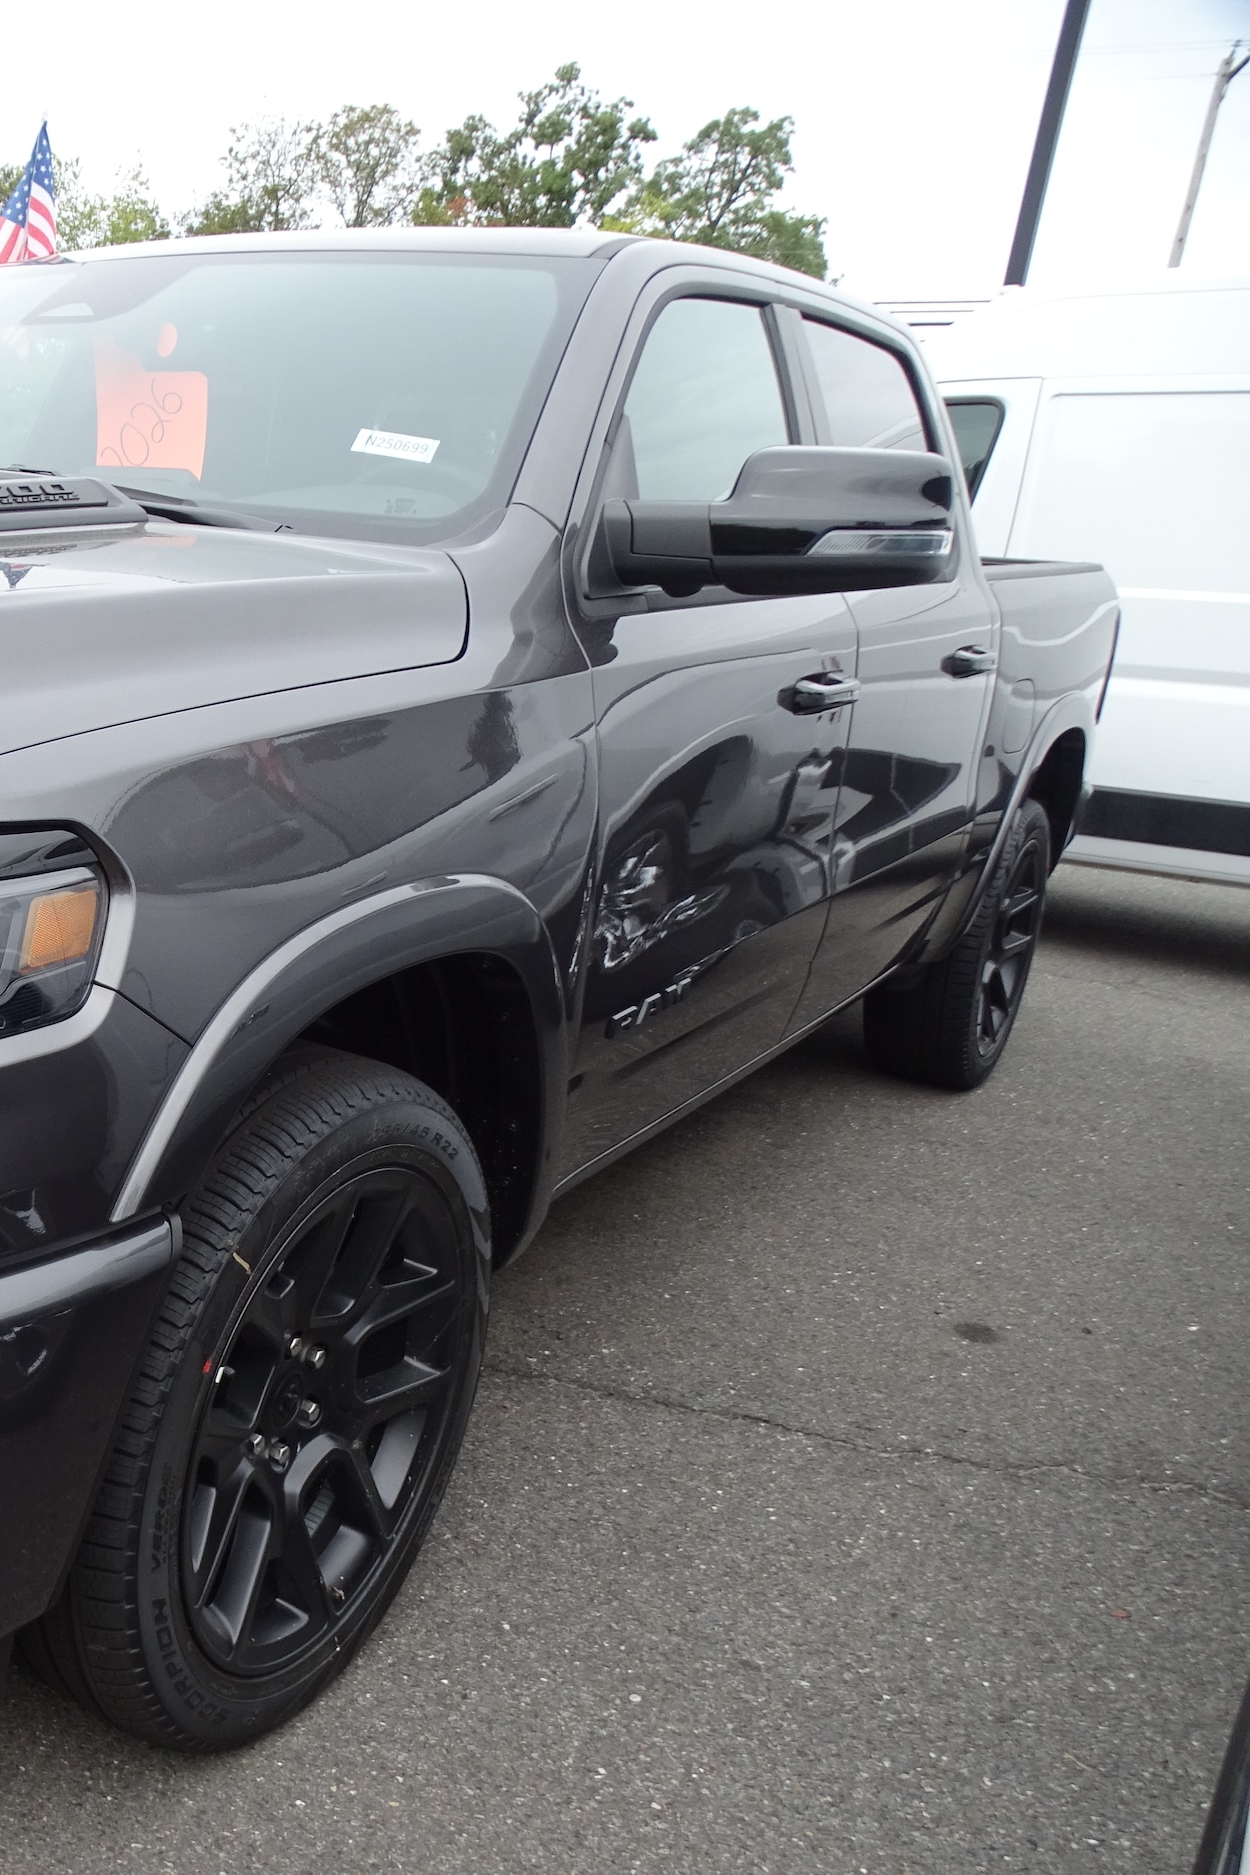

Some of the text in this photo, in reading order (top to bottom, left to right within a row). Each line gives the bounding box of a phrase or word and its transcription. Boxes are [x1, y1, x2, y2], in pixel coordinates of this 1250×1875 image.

[365, 434, 429, 455] N250699
[430, 1131, 459, 1161] R22
[152, 1598, 231, 1723] SCORPION
